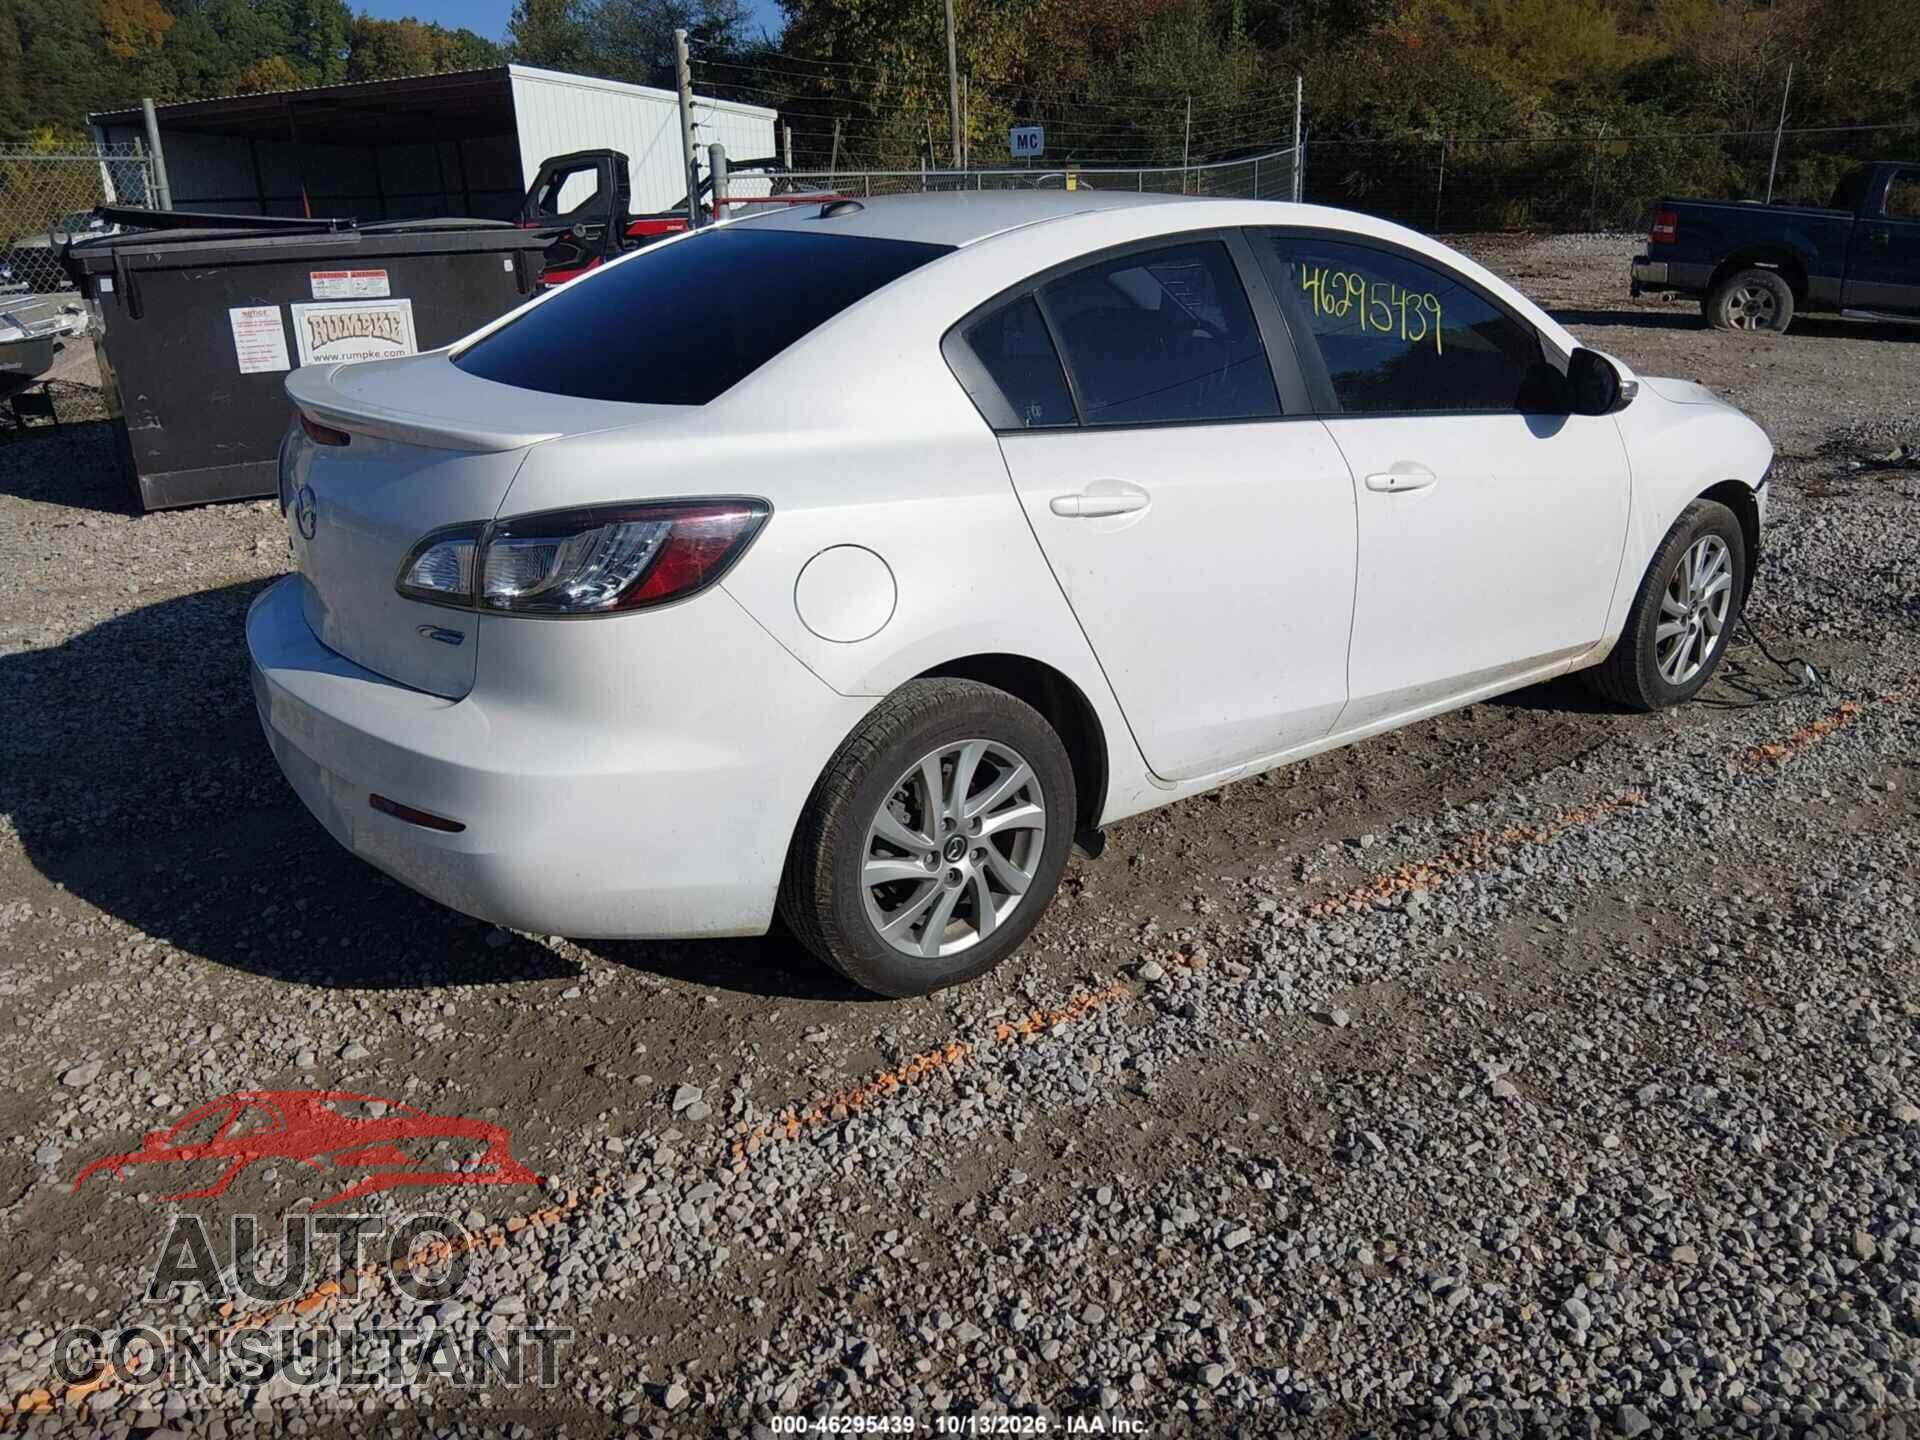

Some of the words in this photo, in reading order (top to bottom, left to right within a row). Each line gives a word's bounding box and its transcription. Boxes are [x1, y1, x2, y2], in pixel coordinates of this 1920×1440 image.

[1016, 134, 1039, 150] MC
[1302, 263, 1442, 356] 46295439
[307, 311, 404, 351] RUMPKE
[312, 349, 406, 362] www.rumpke.com
